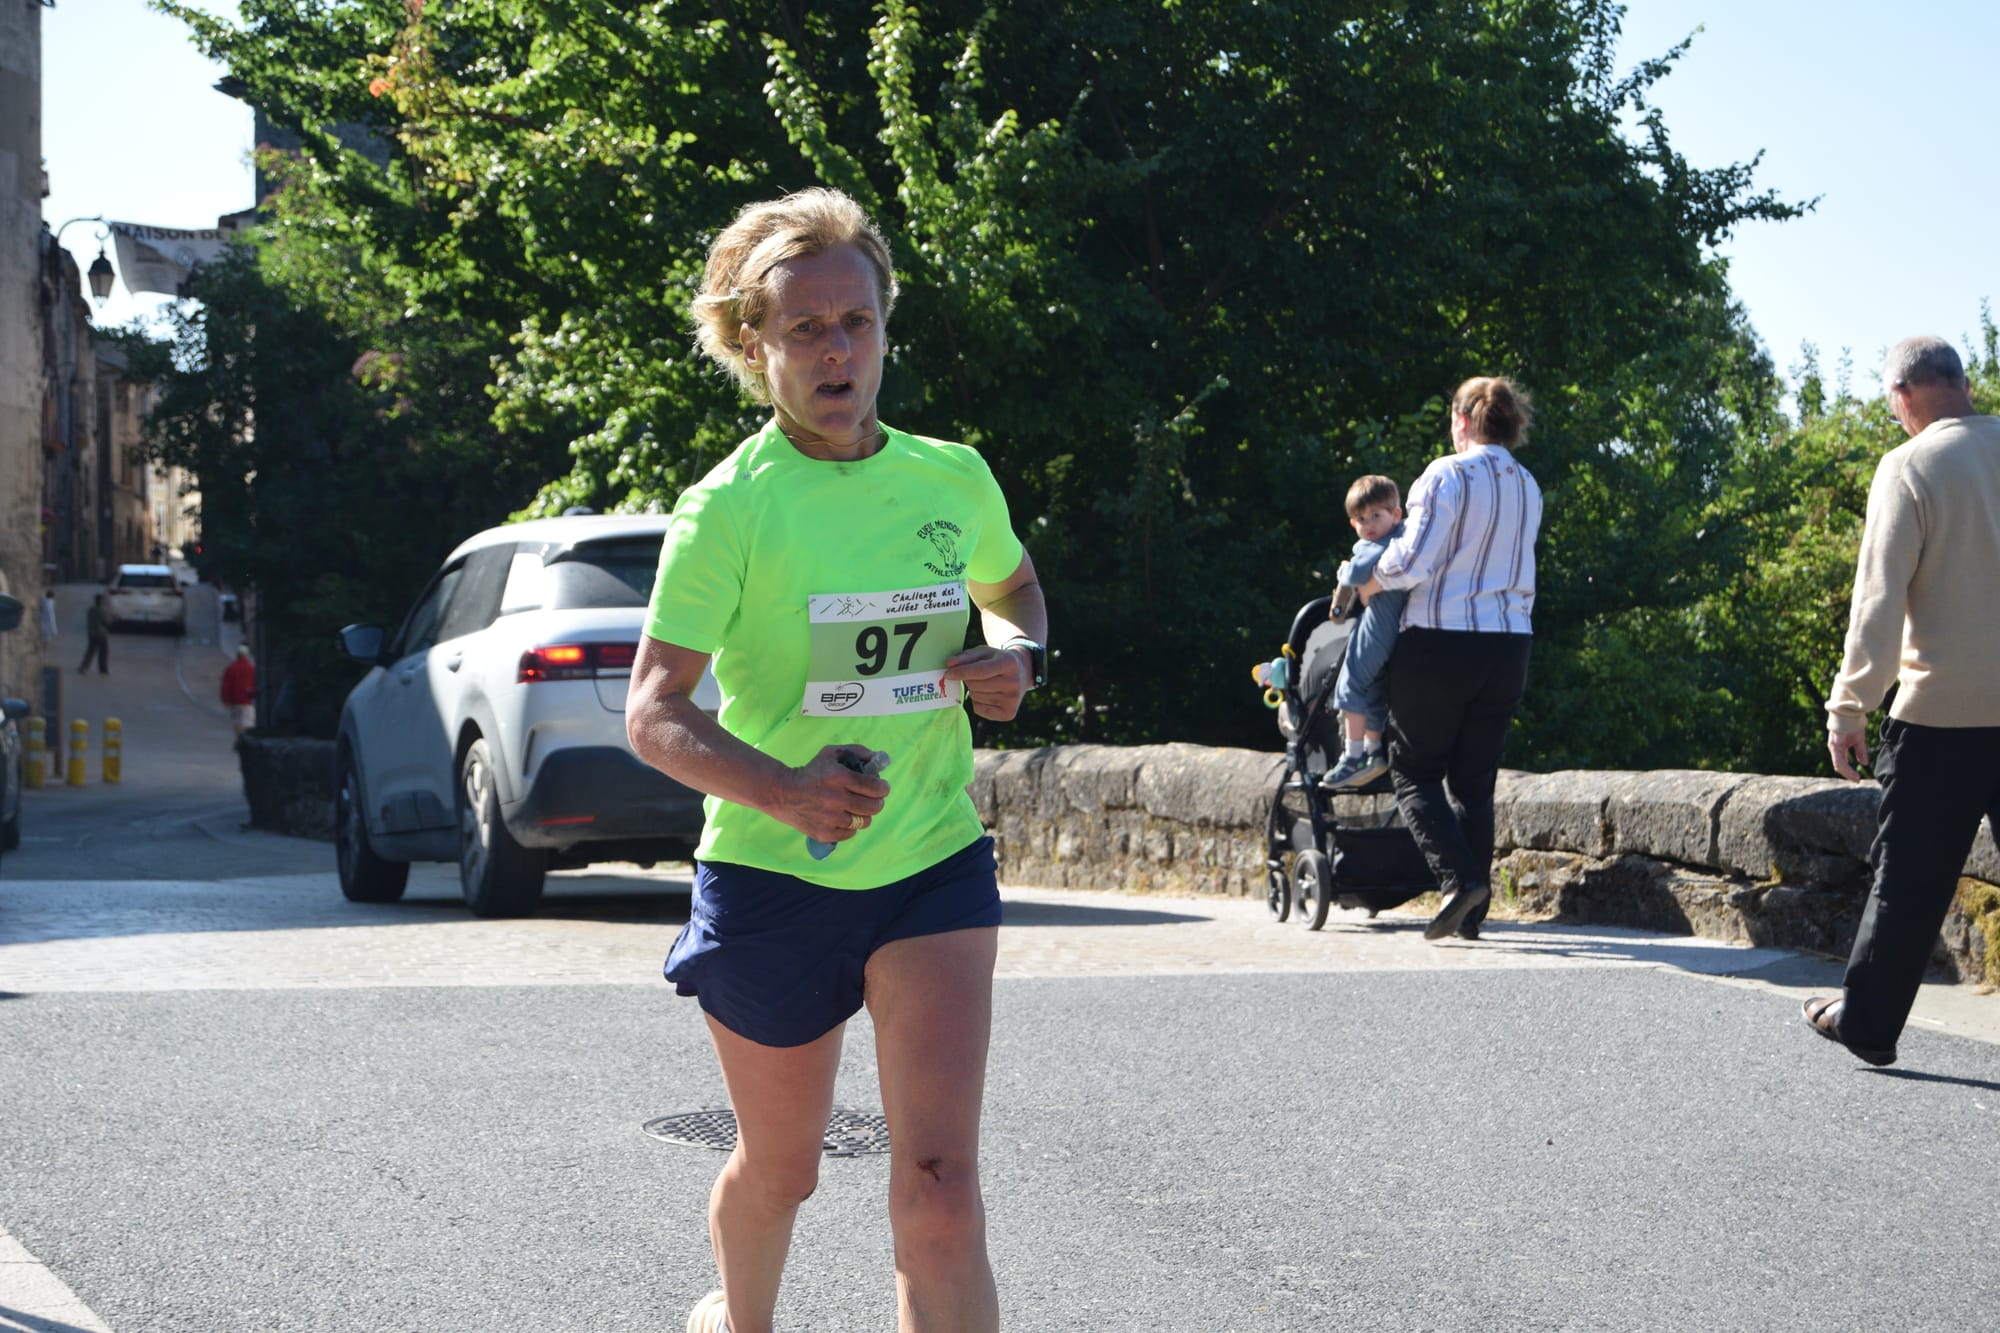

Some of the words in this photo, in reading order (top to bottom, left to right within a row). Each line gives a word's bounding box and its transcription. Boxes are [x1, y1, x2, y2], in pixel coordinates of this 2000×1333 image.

[892, 591, 937, 603] Challenge
[942, 587, 954, 597] des
[886, 602, 919, 613] vallées
[855, 621, 928, 676] 97
[820, 692, 858, 703] BFP
[892, 683, 935, 698] TUFF'S
[896, 691, 940, 705] Aventure
